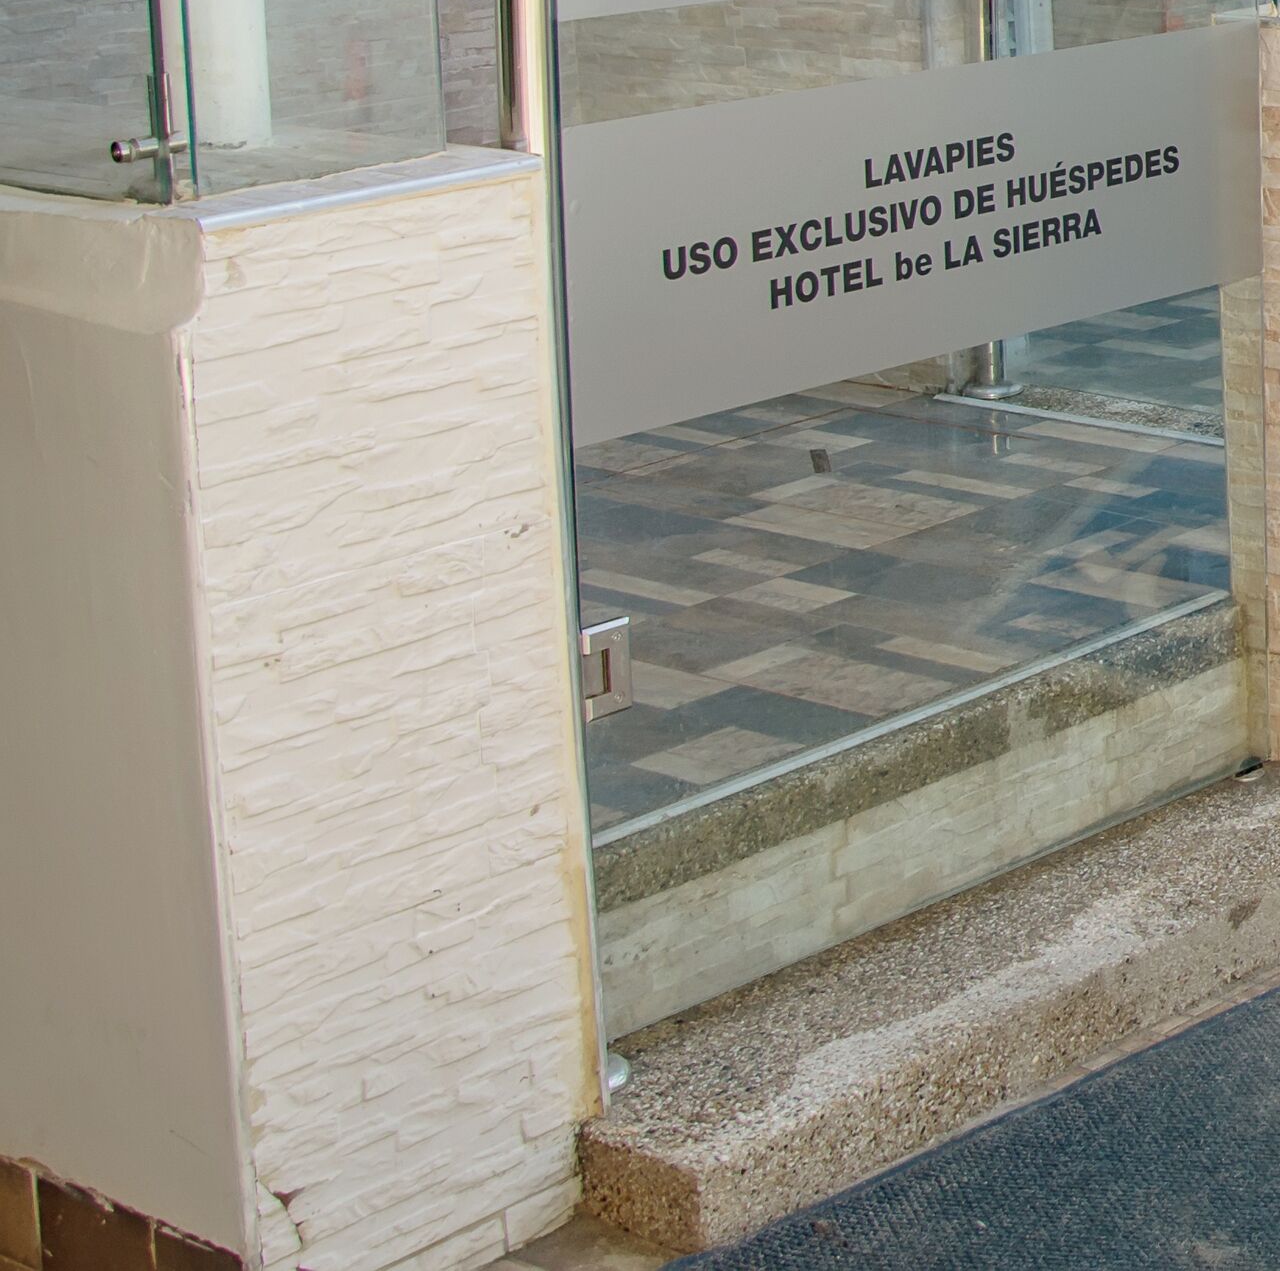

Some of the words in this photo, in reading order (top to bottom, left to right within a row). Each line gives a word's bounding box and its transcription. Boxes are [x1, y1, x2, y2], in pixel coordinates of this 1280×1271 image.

[865, 133, 1014, 189] LAVAPIES
[663, 237, 737, 279] USO
[752, 196, 941, 262] EXCLUSIVO
[954, 184, 995, 219] DE
[1007, 146, 1179, 208] HUÉSPEDES
[771, 259, 883, 309] HOTEL
[897, 248, 932, 281] be
[945, 236, 983, 270] LA
[993, 209, 1101, 258] SIERRA
